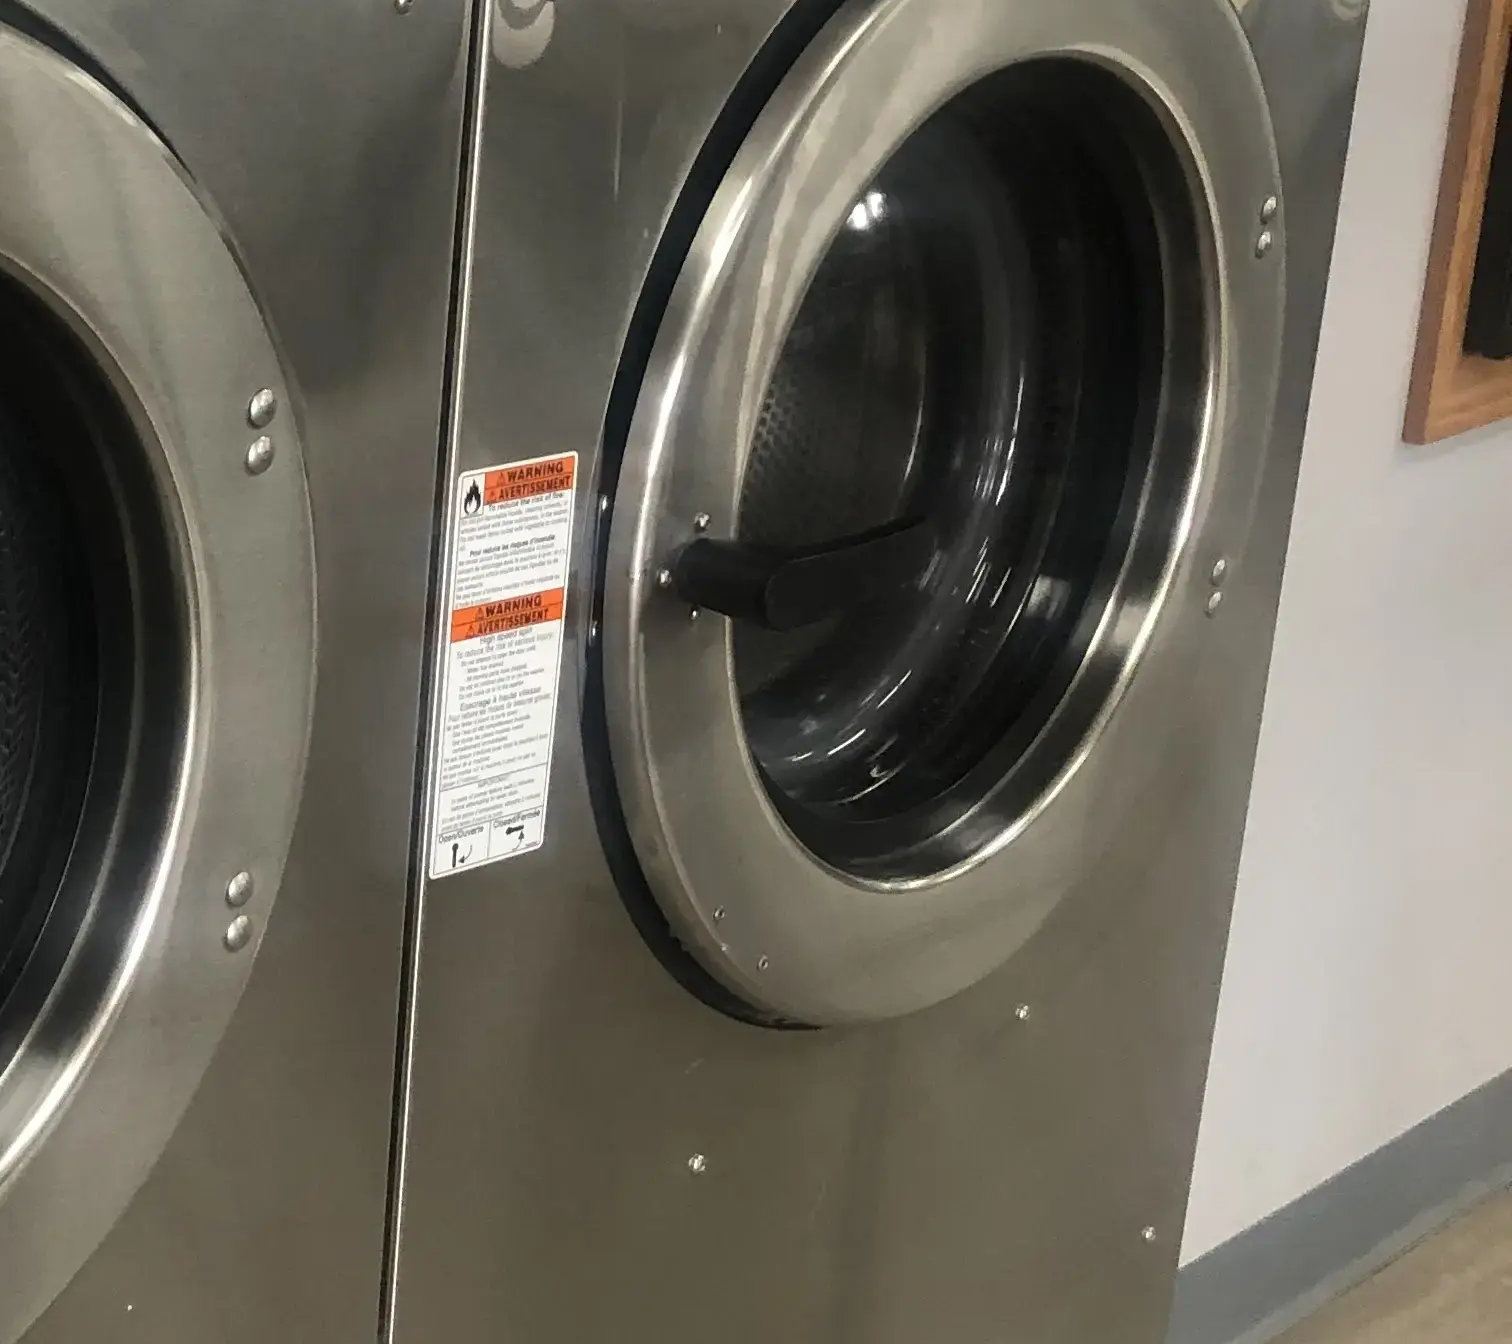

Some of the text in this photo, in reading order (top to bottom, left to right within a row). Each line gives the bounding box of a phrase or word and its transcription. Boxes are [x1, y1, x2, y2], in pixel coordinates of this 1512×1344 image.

[507, 461, 563, 482] WARNING
[499, 475, 571, 501] AVERTISSEMENT
[486, 595, 542, 617] WARNING
[477, 609, 549, 635] AVERTISSEMENT
